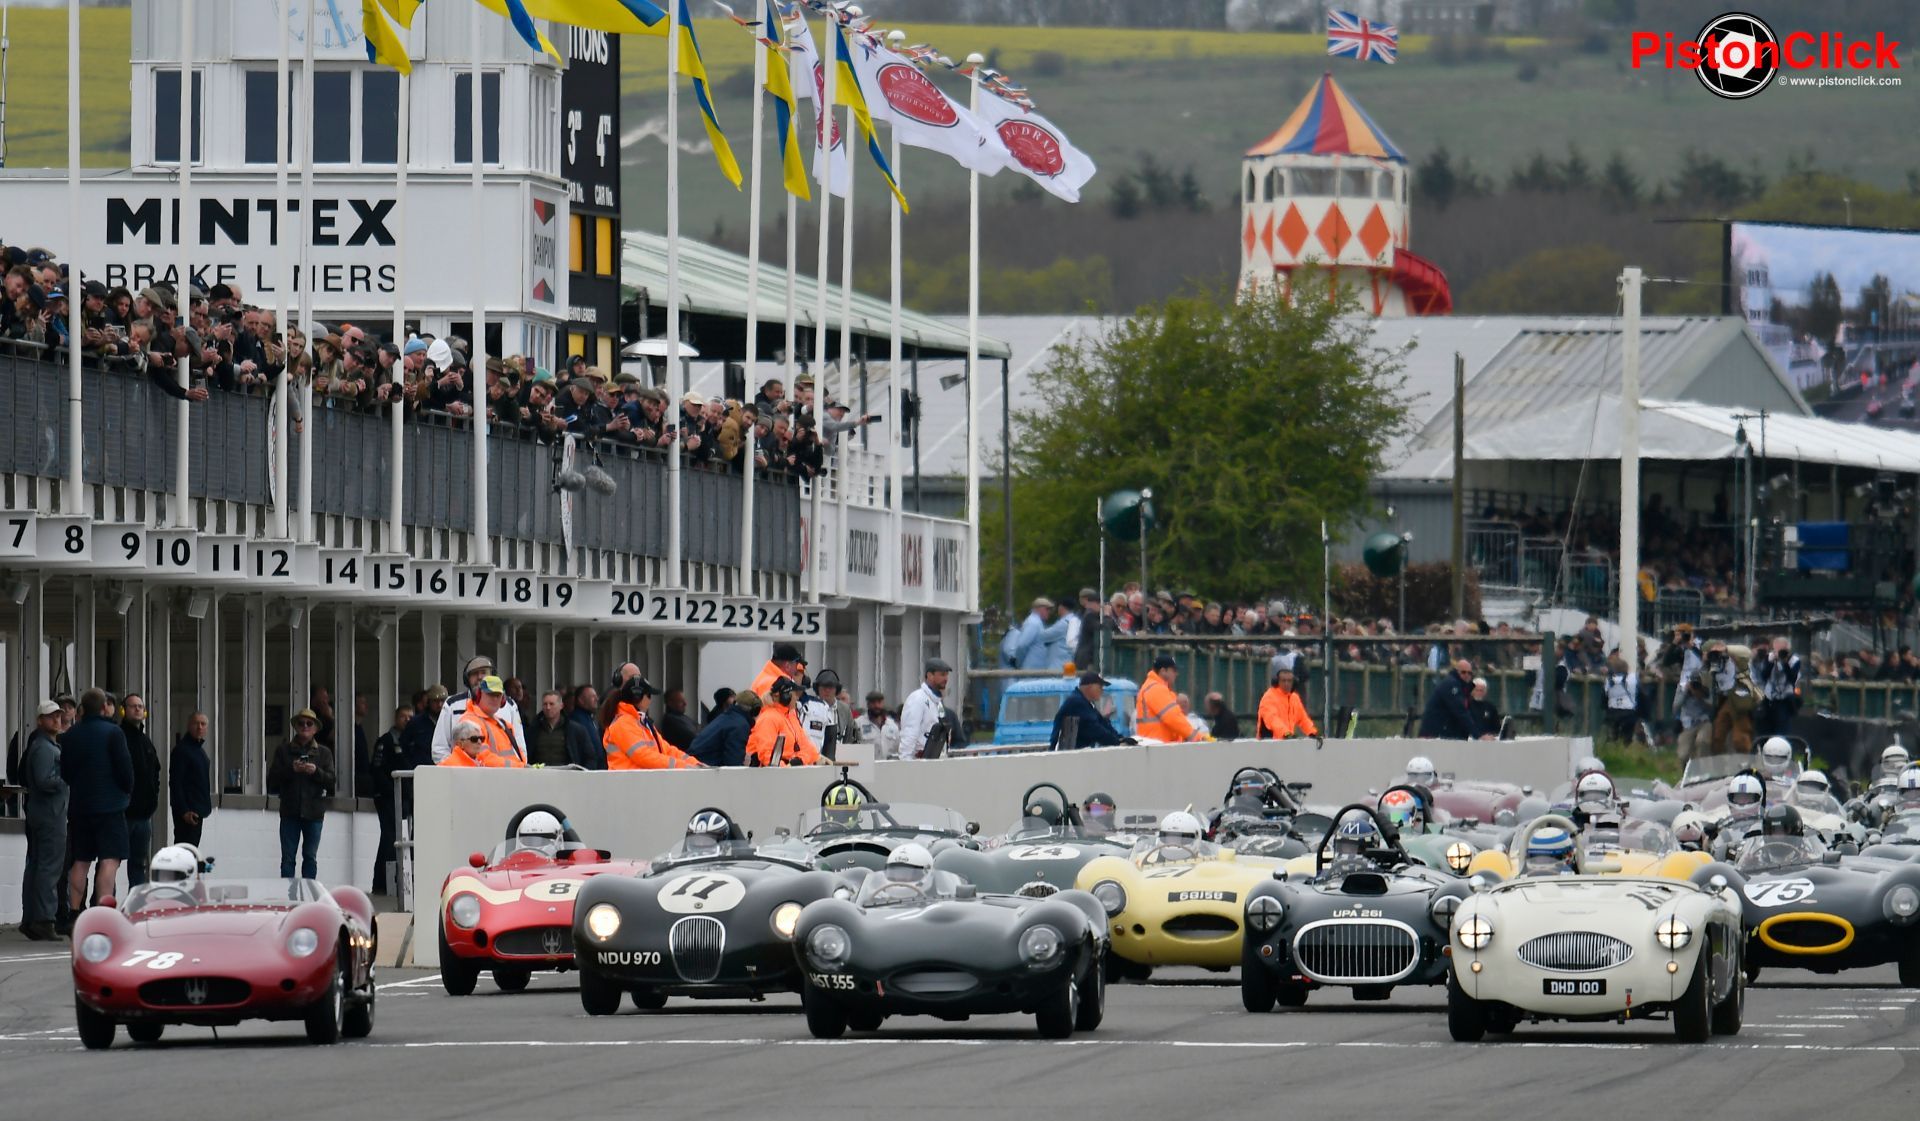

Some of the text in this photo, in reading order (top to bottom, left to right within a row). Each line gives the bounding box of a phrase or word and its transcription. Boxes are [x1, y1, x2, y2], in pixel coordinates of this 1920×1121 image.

[106, 198, 397, 246] MINTEX
[256, 264, 396, 292] LNERS
[9, 519, 28, 548] 7
[64, 525, 84, 554] 8
[121, 532, 140, 560] 9
[156, 538, 191, 566] 10
[213, 544, 240, 571] 11
[257, 550, 289, 577] 12
[848, 529, 879, 577] DUNLOP
[901, 534, 923, 587] UCAS
[326, 558, 358, 584] 14
[374, 563, 405, 590] 15
[415, 568, 447, 594] 16
[458, 573, 488, 598] 17
[501, 577, 531, 602] 18
[543, 583, 572, 607] 19
[612, 591, 644, 616] 20
[651, 595, 682, 621] 21
[686, 600, 718, 624] 22
[723, 604, 753, 628] 23
[758, 608, 785, 631] 24
[792, 612, 820, 635] 25
[549, 882, 572, 894] 8
[671, 875, 729, 900] 11
[1751, 882, 1811, 901] 75
[1333, 909, 1383, 918] UPA 261
[121, 949, 185, 970] 78
[598, 952, 661, 965] NDU 970
[831, 974, 856, 990] 355
[1551, 981, 1600, 994] DHD 100
